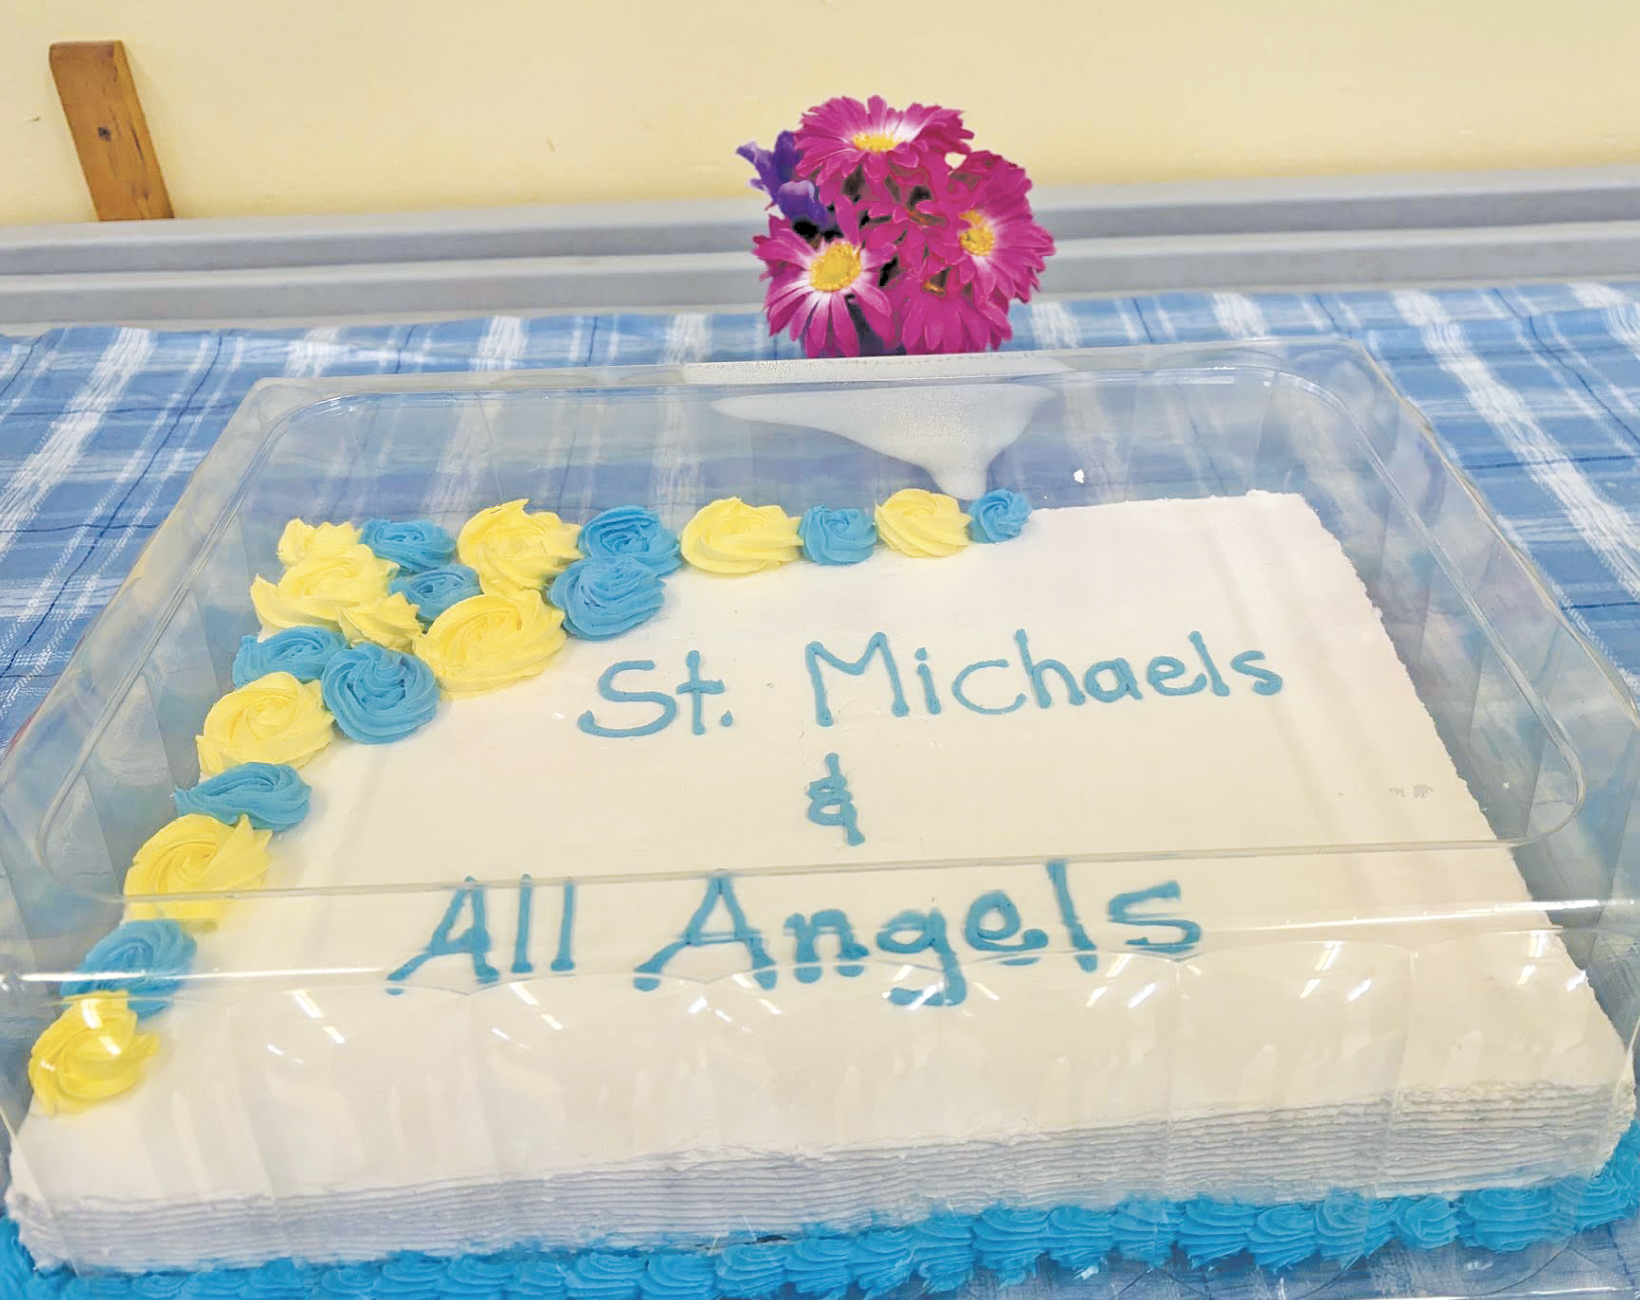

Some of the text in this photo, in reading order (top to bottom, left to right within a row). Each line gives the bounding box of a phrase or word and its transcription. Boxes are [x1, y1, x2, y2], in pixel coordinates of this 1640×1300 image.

[578, 629, 1283, 739] St. Michaels
[806, 753, 866, 847] &
[387, 862, 1203, 1008] All Angels
